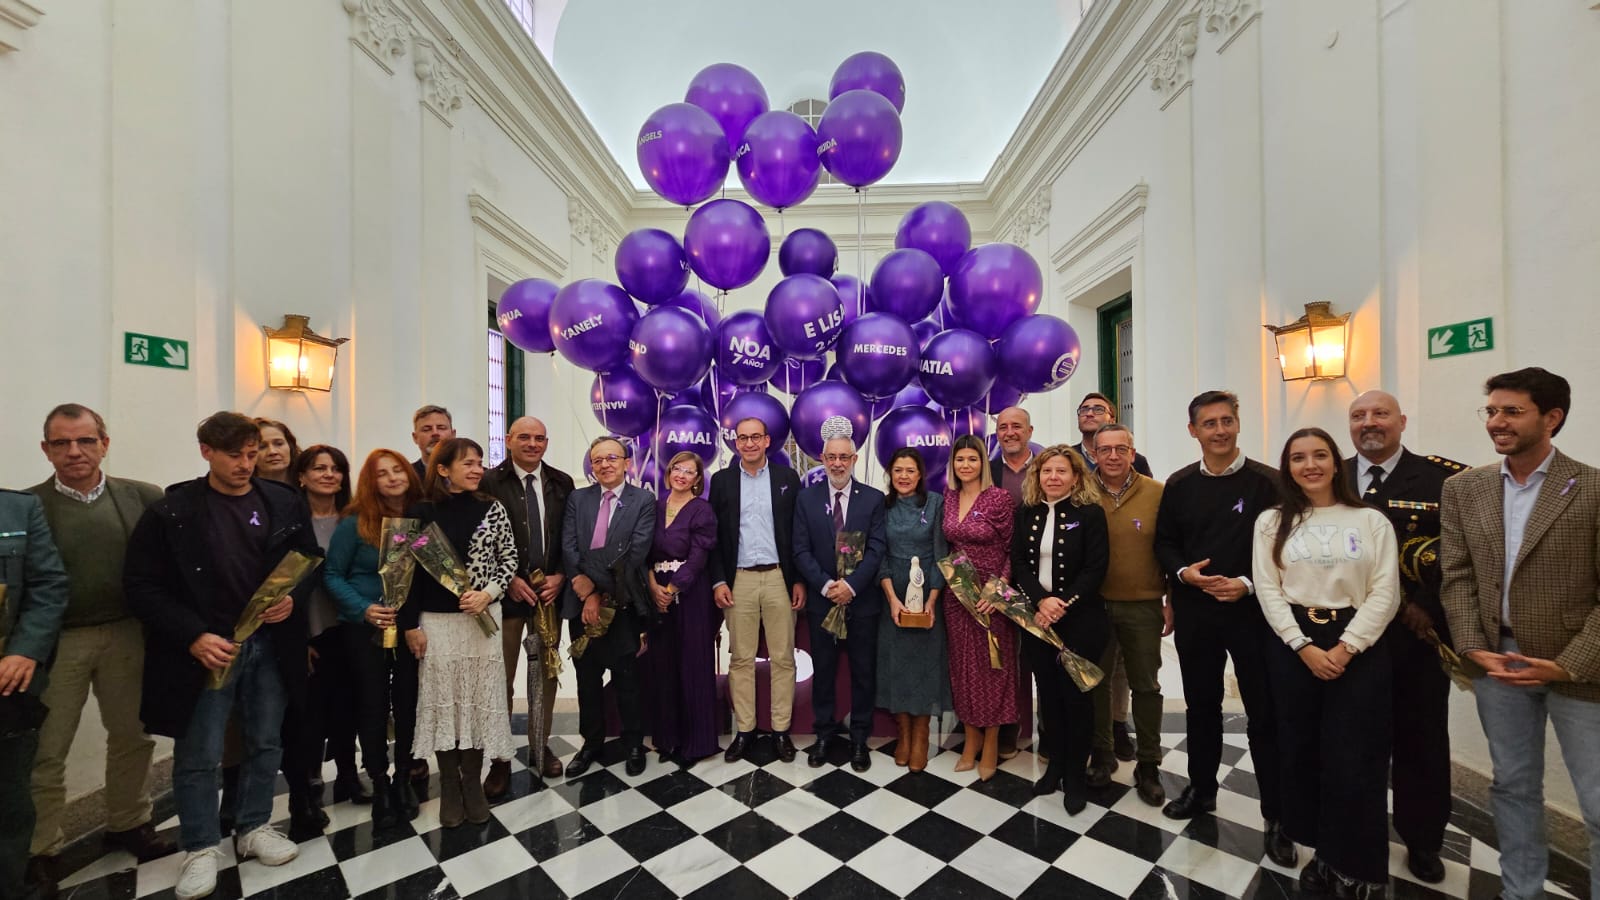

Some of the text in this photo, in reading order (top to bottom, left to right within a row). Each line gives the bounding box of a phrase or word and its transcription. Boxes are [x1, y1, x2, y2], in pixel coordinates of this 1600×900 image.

[561, 314, 603, 341] YANELY
[729, 335, 770, 361] NOA
[853, 342, 908, 357] MERCEDES
[731, 352, 765, 369] 7 AÑOS
[665, 430, 713, 446] AMAL
[905, 434, 951, 448] LAURA
